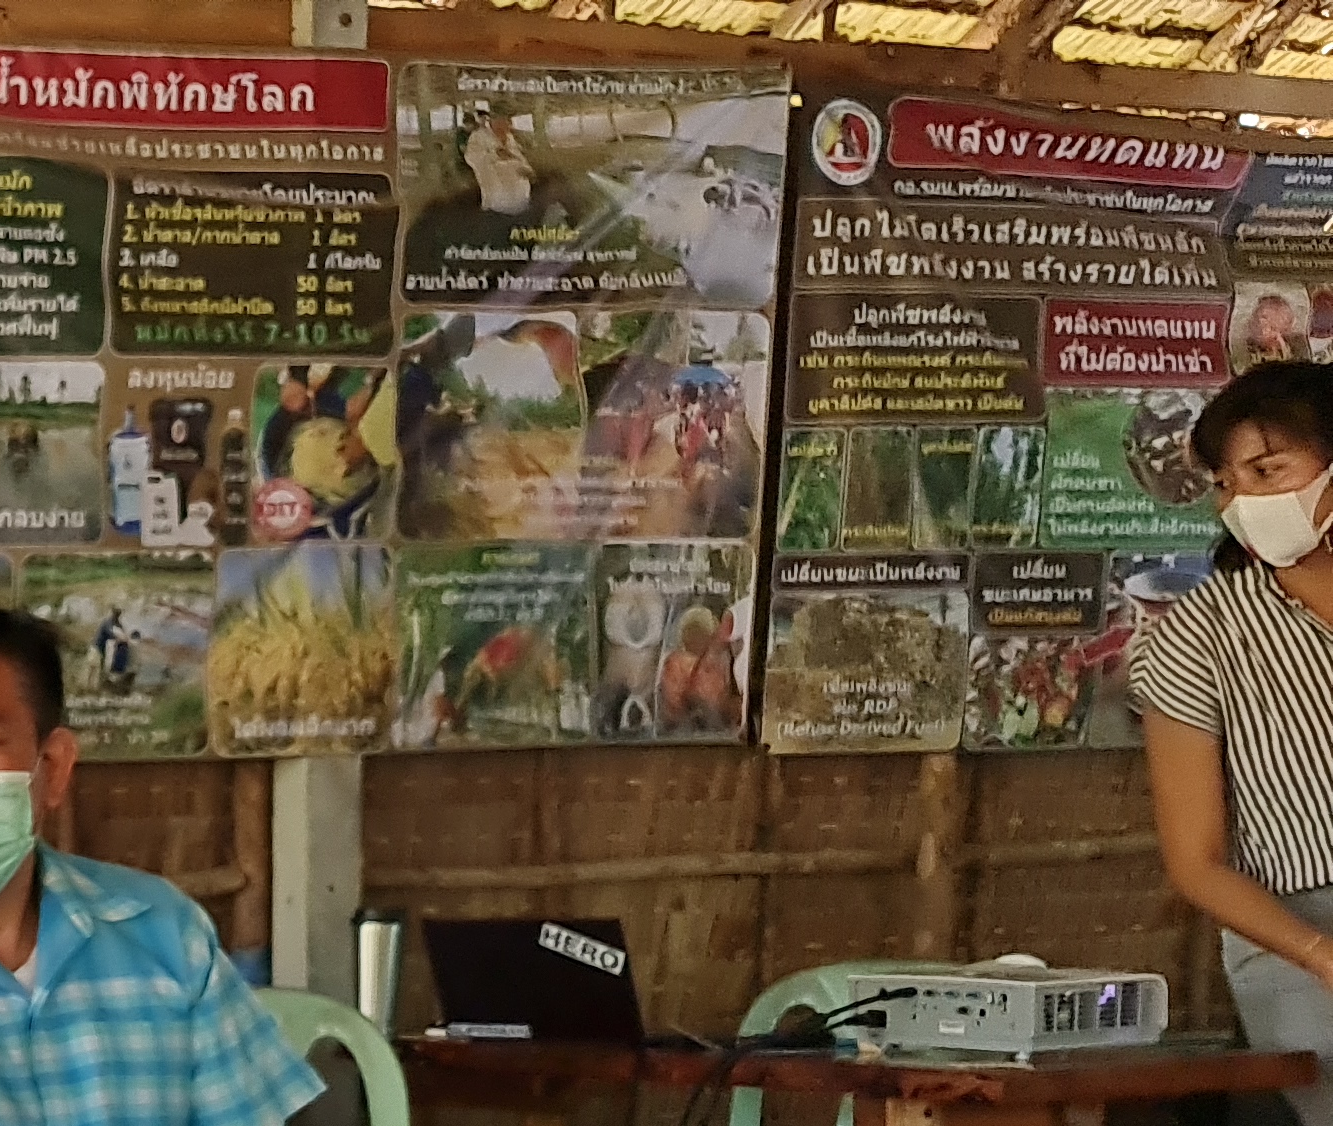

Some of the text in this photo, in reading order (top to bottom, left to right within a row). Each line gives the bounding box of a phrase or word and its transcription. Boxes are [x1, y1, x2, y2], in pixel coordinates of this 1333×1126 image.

[924, 117, 1226, 172] พลังงานทดแทน
[1052, 308, 1217, 341] พลังงานทดแทน
[543, 928, 619, 969] HERO
